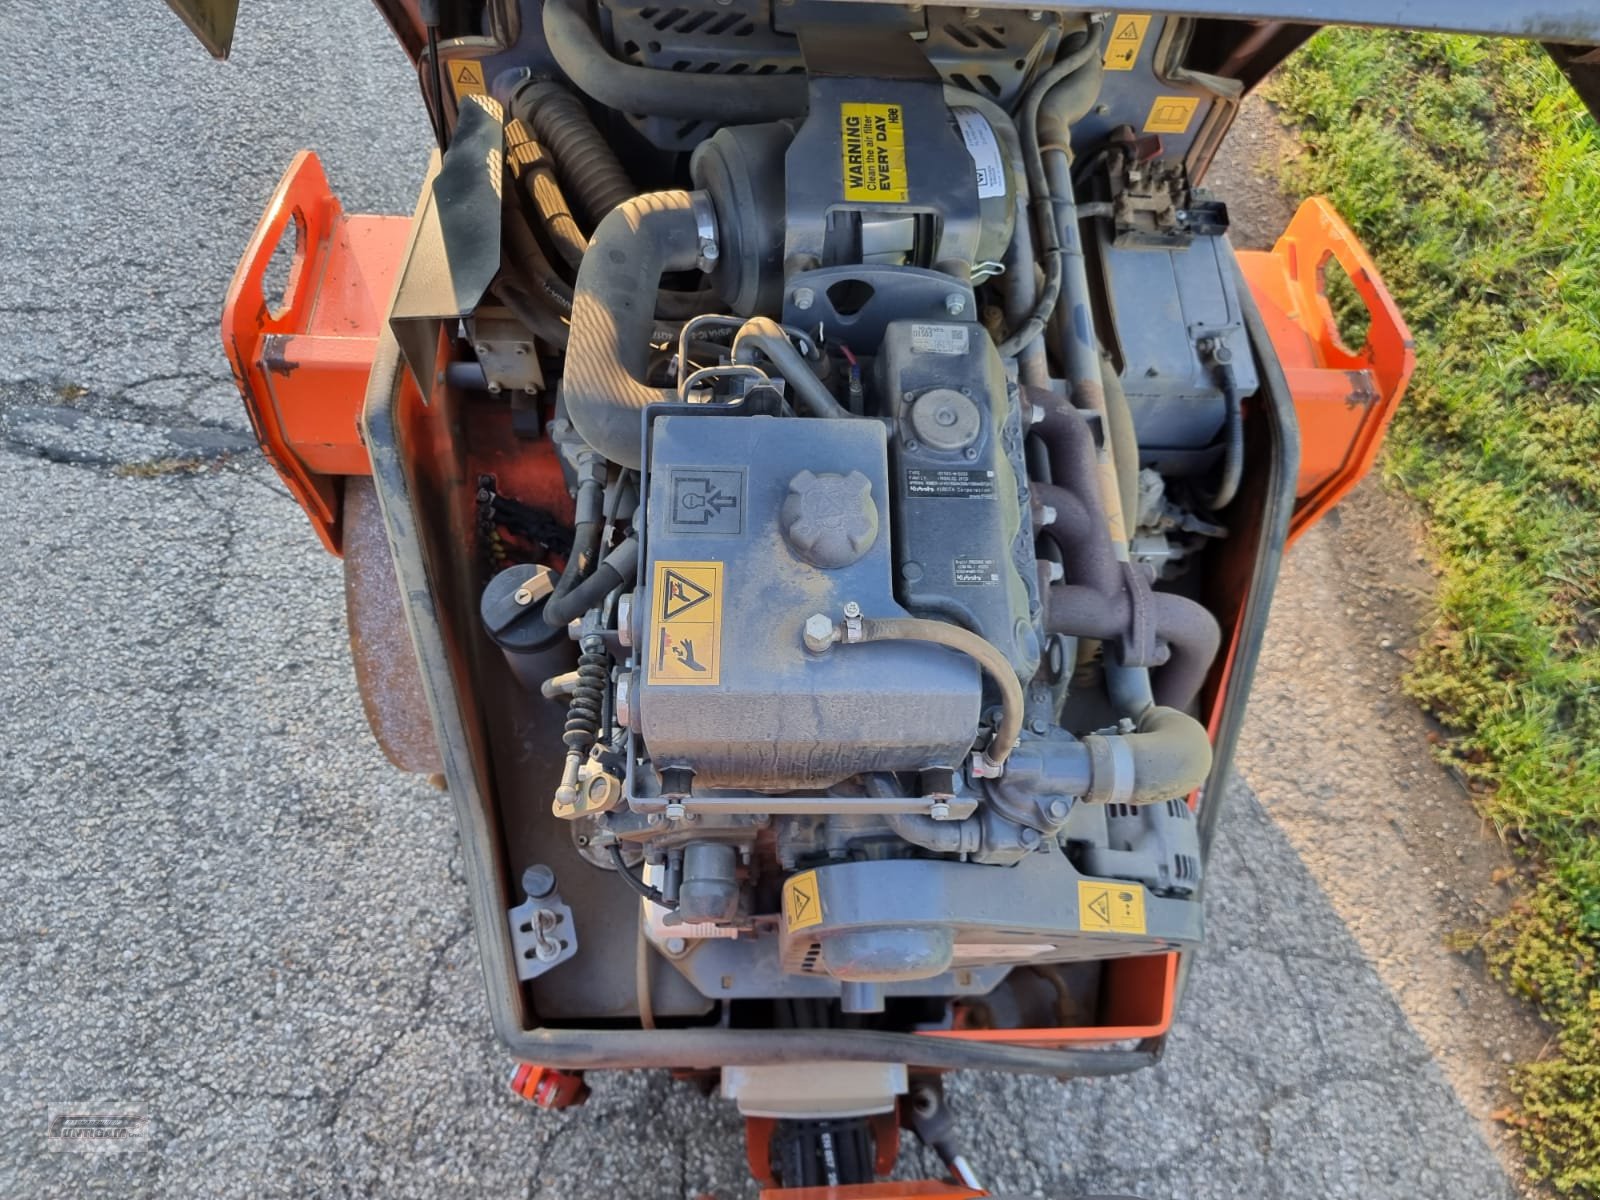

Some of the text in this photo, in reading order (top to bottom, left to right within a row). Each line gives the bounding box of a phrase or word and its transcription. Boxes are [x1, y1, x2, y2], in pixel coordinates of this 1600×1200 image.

[846, 116, 863, 188] WARNING
[863, 115, 877, 191] Clean the air filter
[875, 115, 891, 191] EVERY DAY
